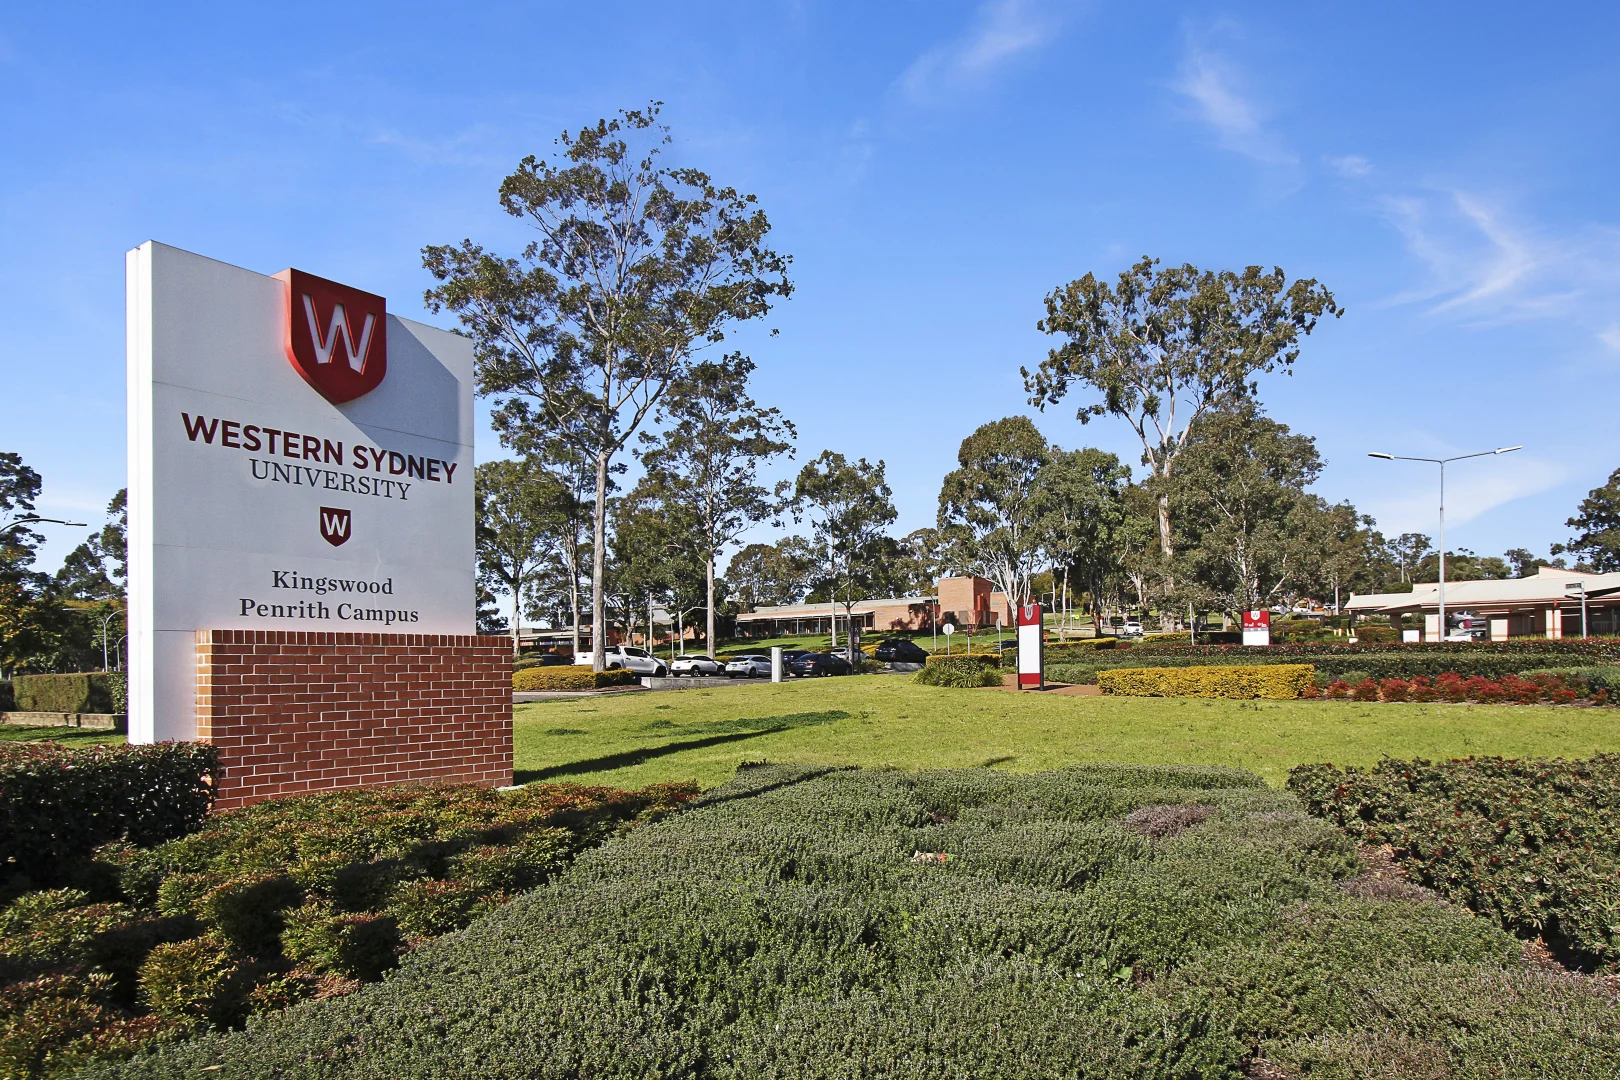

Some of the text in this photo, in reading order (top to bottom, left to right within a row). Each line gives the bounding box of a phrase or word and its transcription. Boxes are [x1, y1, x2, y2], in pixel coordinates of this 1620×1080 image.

[181, 412, 458, 484] WESTERN SYDNEY
[249, 458, 411, 500] UNIVERSITY
[322, 512, 348, 537] W
[272, 570, 393, 595] Kingswood
[239, 598, 419, 625] Penrith Campus
